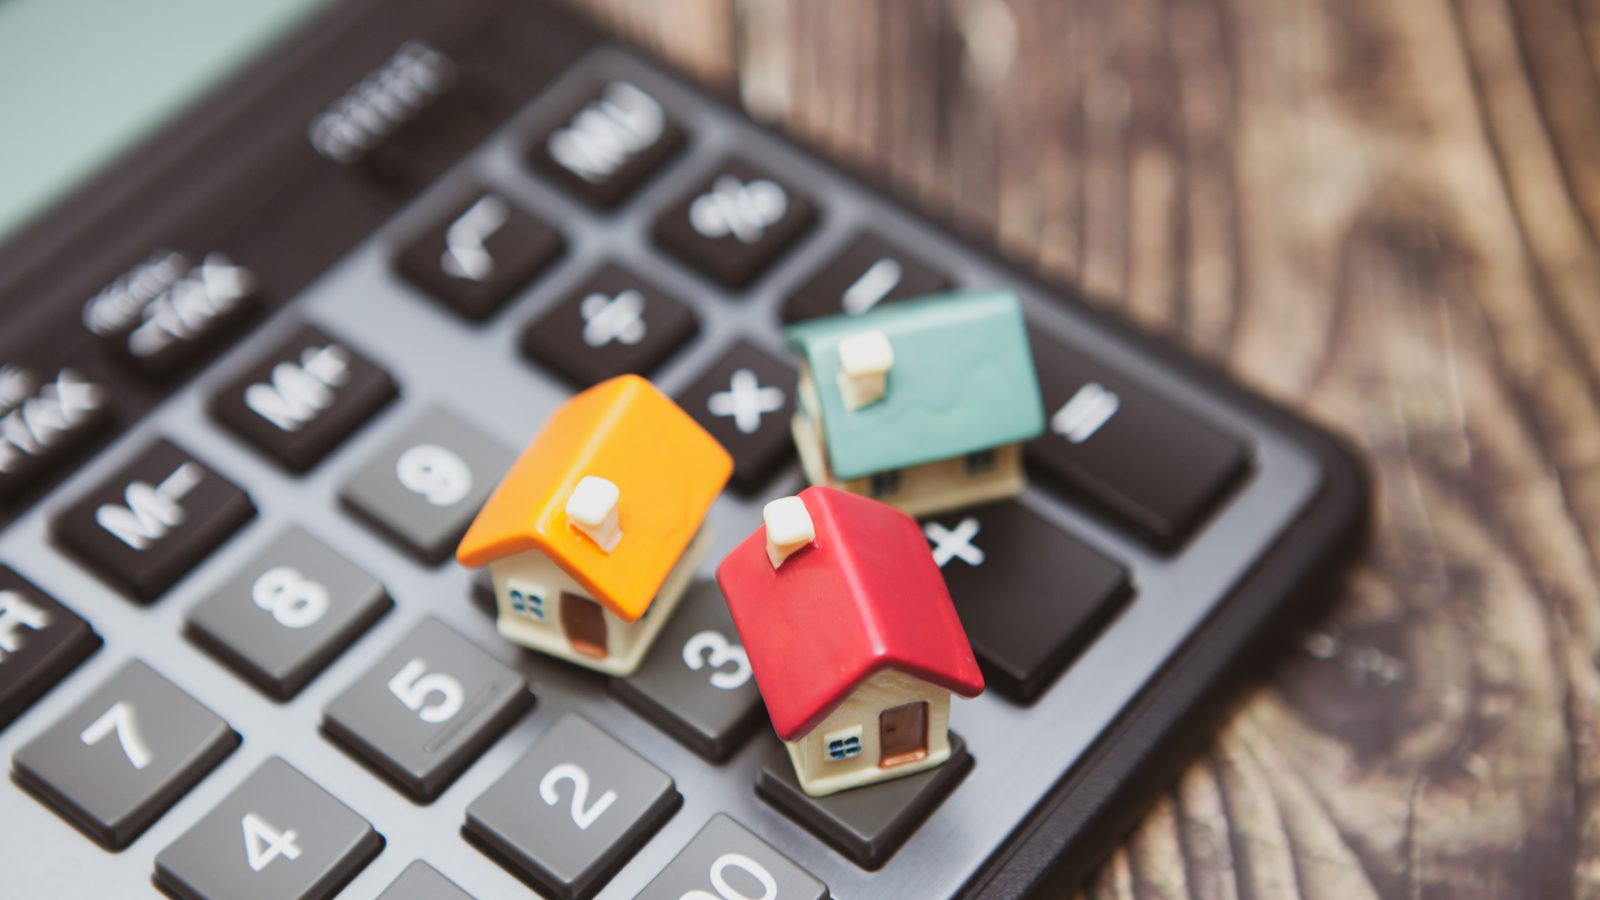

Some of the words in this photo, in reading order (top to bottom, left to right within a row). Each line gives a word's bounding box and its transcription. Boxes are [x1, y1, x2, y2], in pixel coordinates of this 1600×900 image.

[245, 344, 350, 431] M+
[396, 444, 473, 506] 9
[252, 566, 329, 629] 8
[388, 657, 464, 723] 5
[682, 630, 752, 690] 3
[80, 702, 153, 770] 7
[539, 762, 618, 830] 2
[241, 812, 303, 872] 4
